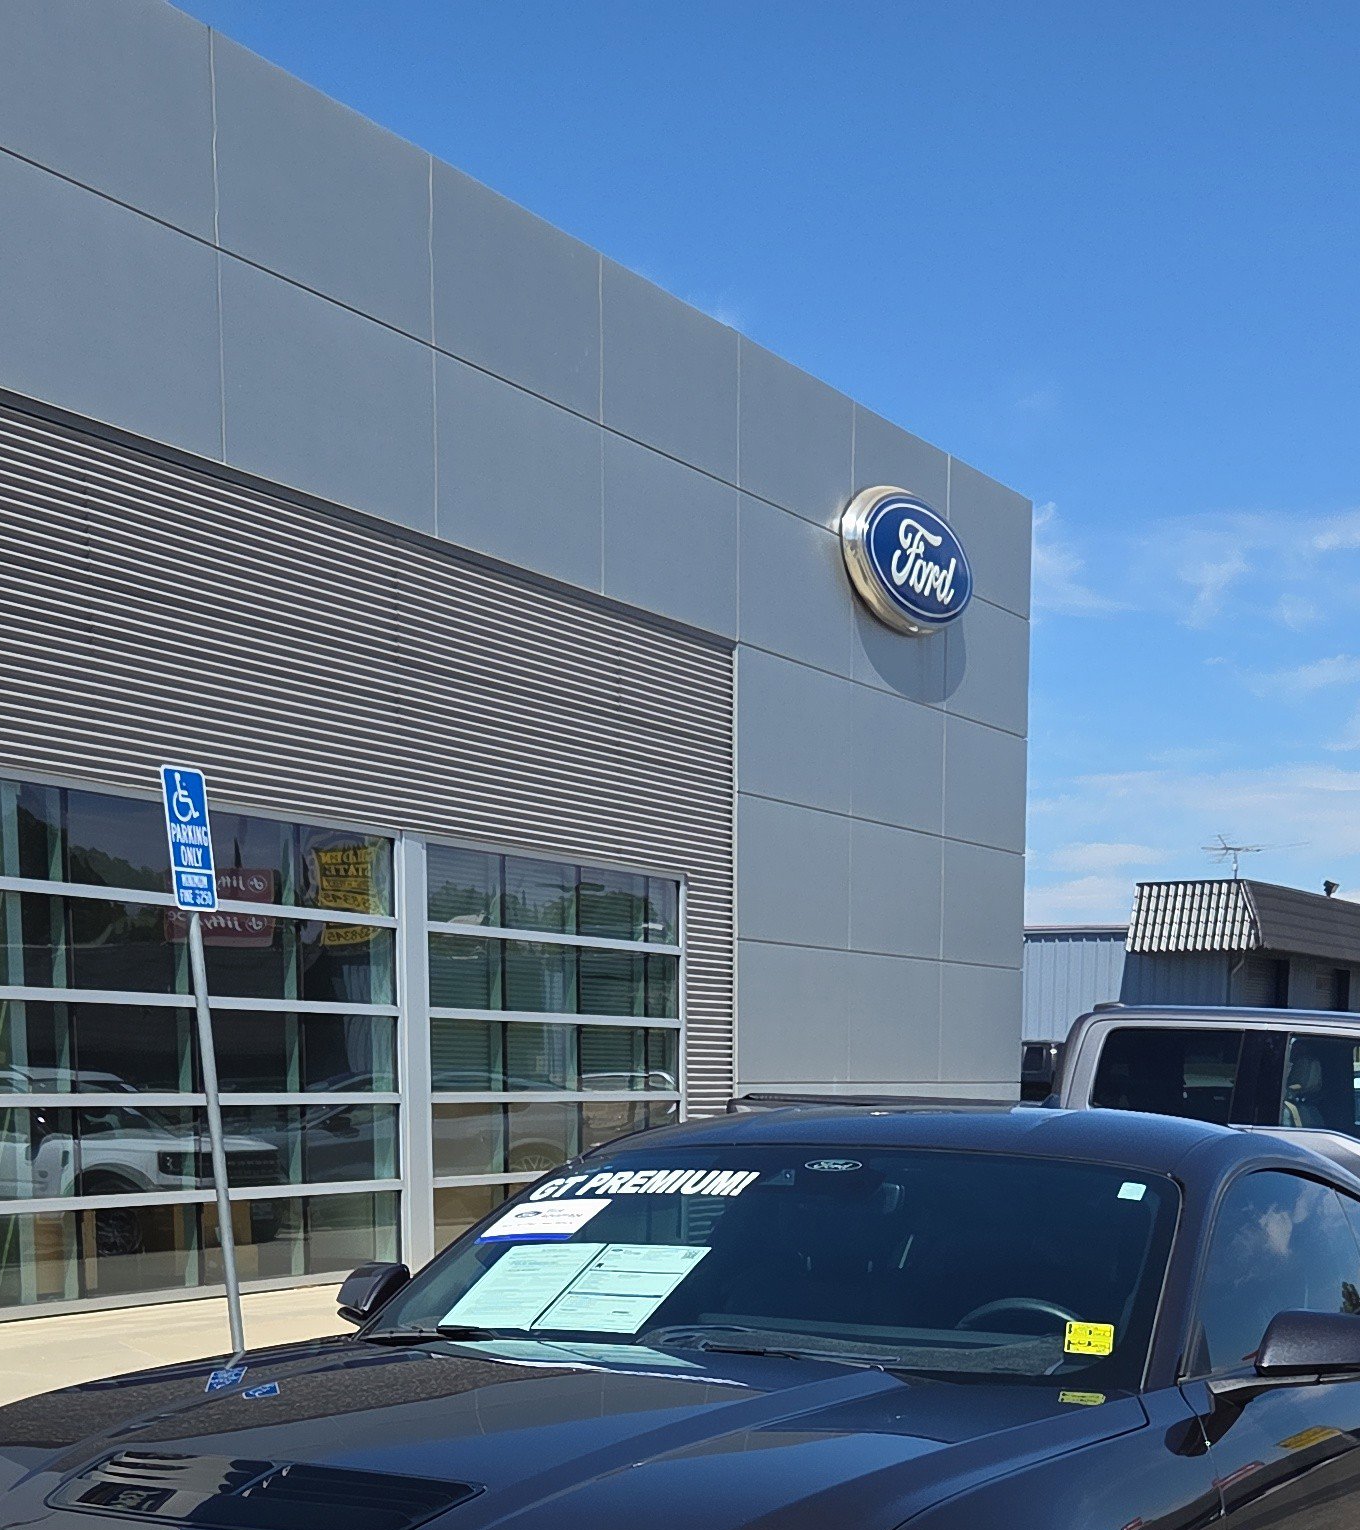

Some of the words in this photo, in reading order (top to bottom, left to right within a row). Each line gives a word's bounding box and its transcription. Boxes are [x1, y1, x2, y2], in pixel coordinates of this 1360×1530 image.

[891, 518, 957, 606] Ford
[171, 822, 209, 847] PARKING
[180, 847, 203, 867] ONLY
[530, 1175, 588, 1200] GT
[575, 1169, 760, 1197] PREMIUM!
